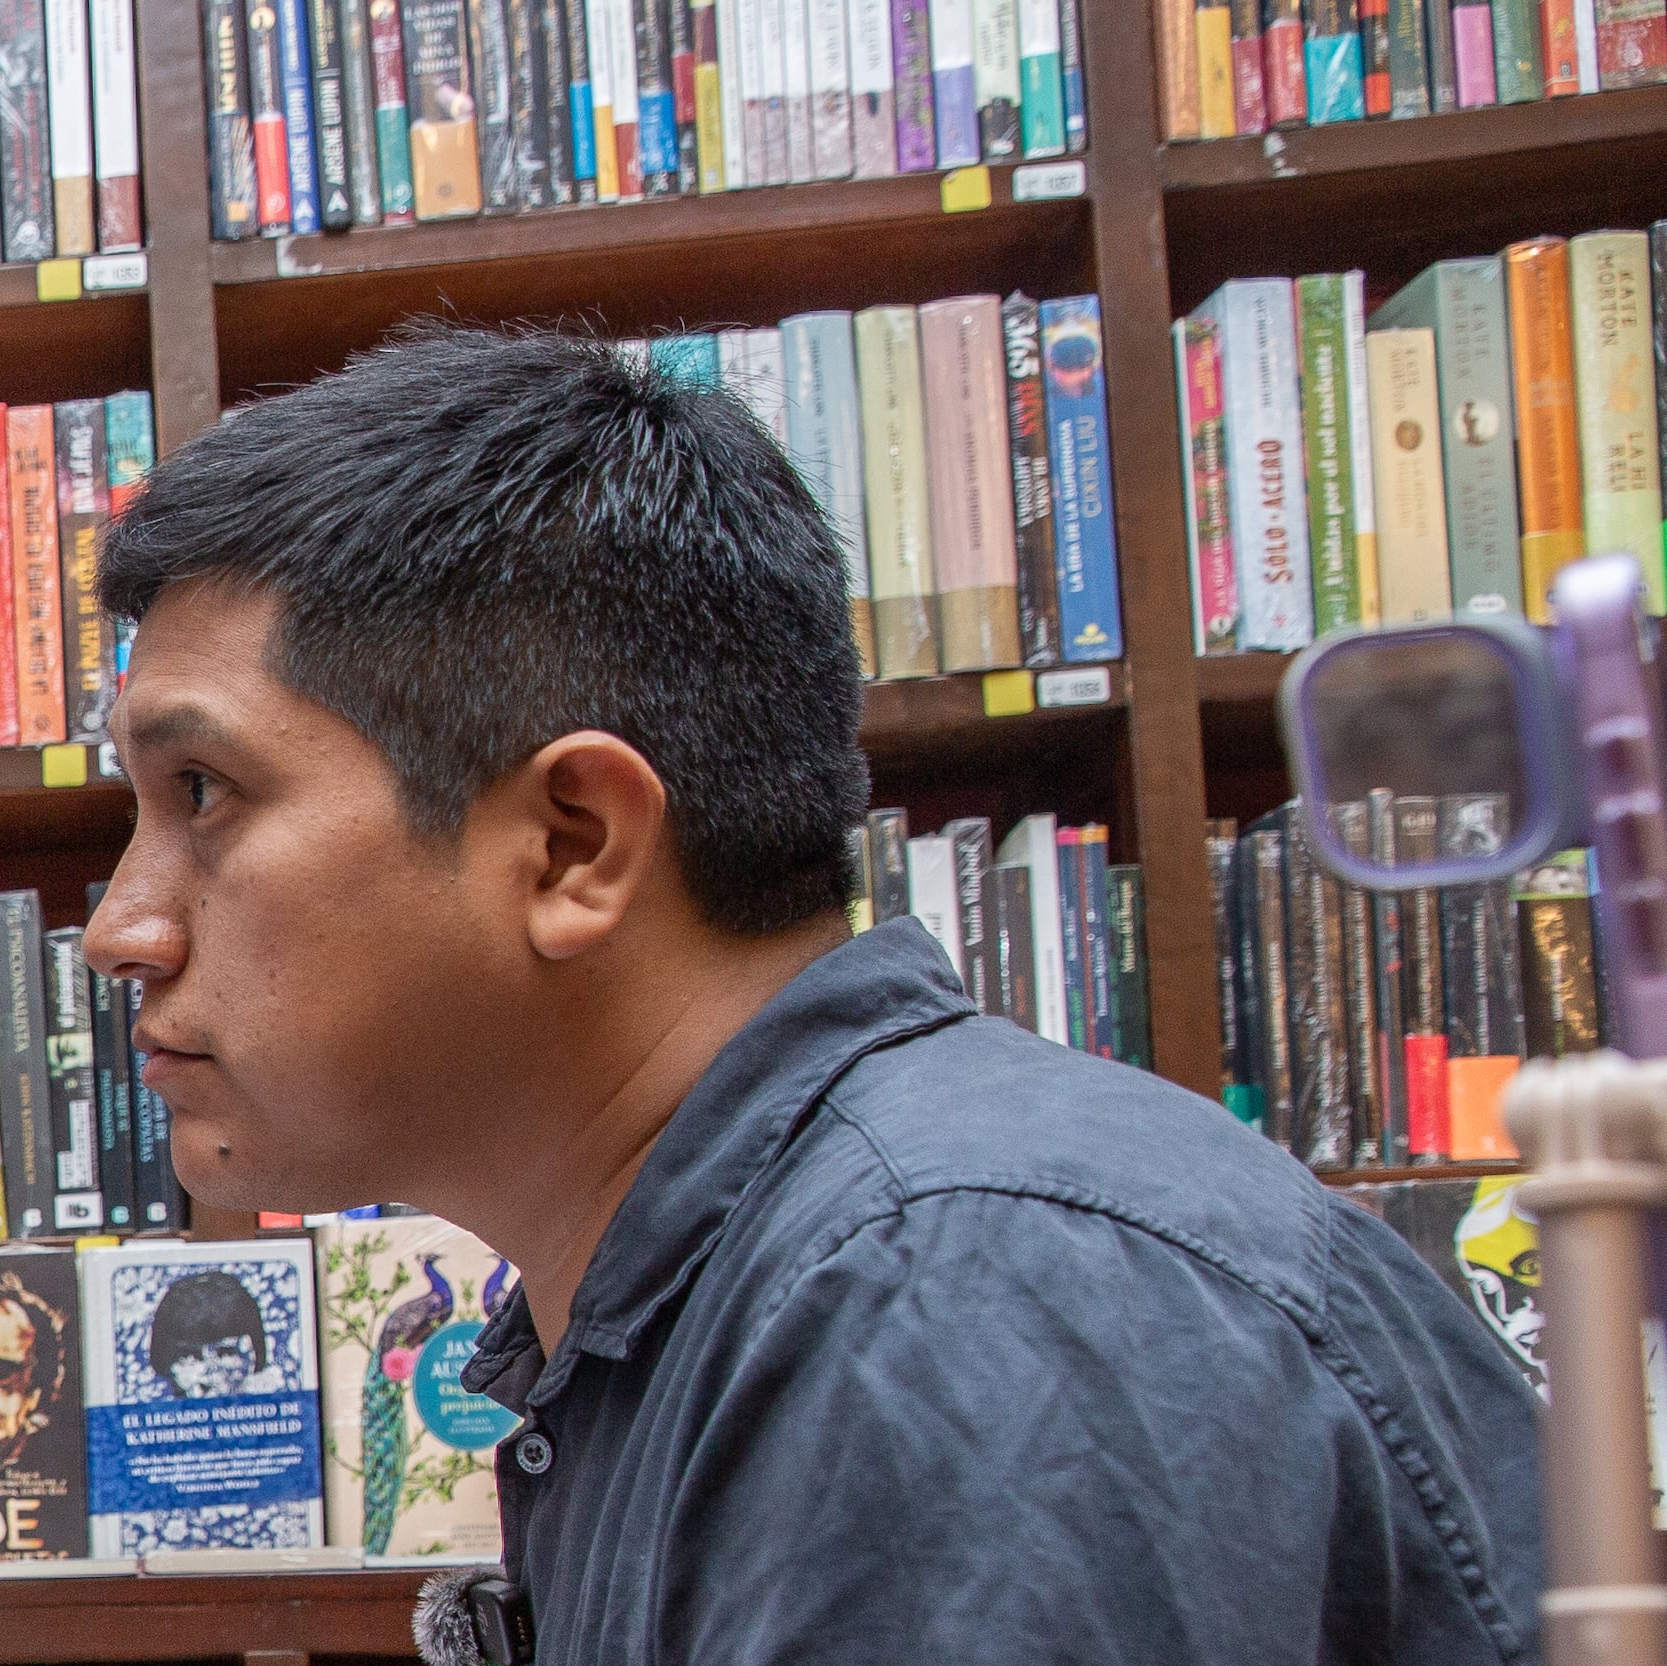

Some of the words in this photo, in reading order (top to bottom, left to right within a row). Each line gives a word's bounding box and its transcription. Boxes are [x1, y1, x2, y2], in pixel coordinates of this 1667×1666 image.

[1596, 254, 1620, 348] MORTON
[1620, 269, 1637, 329] KATE
[1077, 416, 1097, 451] LIU
[1081, 456, 1102, 517] CIXIN
[122, 1414, 140, 1430] EL
[144, 1409, 209, 1427] LEGADO
[279, 1402, 301, 1417] DE
[125, 1425, 214, 1446] KATHERINE
[216, 1419, 303, 1439] MANSFIELD
